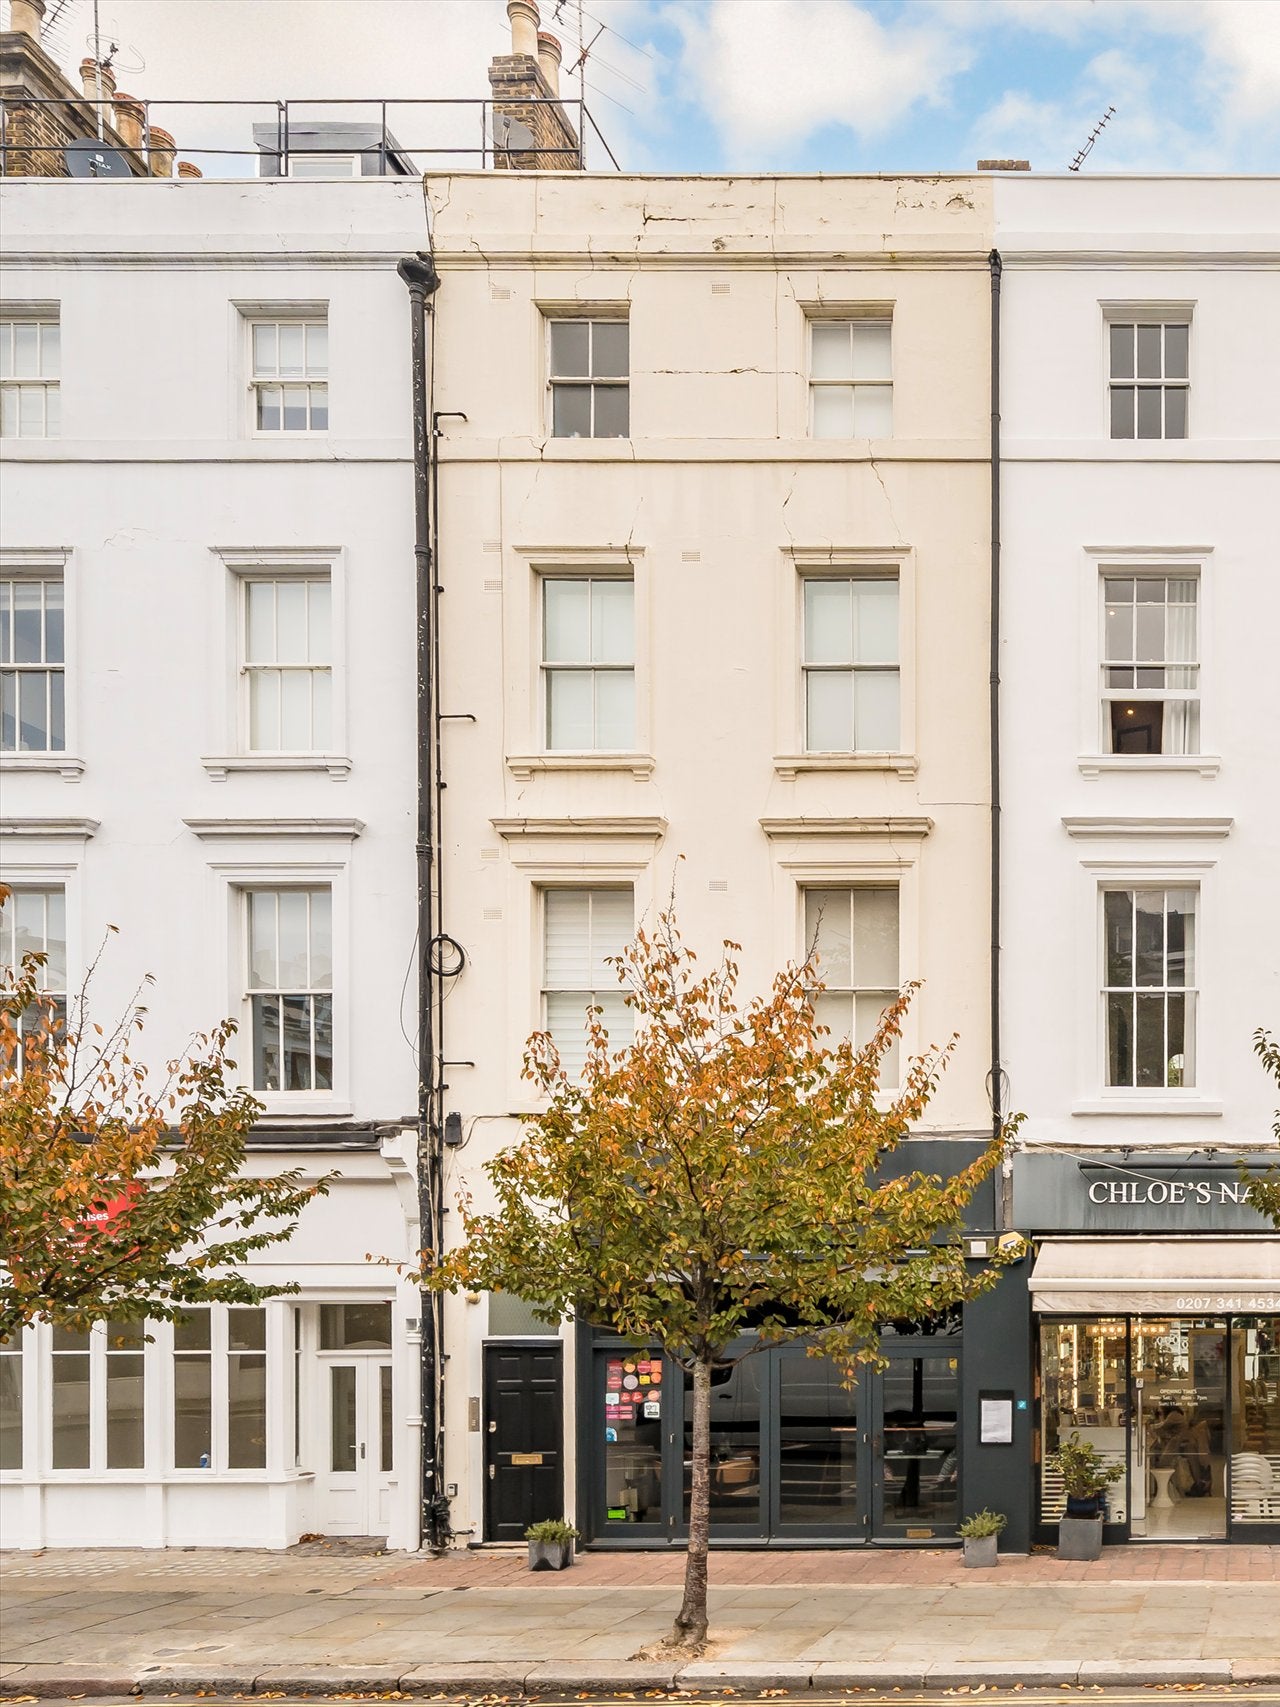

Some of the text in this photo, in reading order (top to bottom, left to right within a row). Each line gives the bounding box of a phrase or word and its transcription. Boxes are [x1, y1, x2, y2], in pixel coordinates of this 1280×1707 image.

[1088, 1181, 1212, 1205] CHLOE'S
[1176, 1297, 1211, 1310] 0207
[1216, 1297, 1242, 1310] 341
